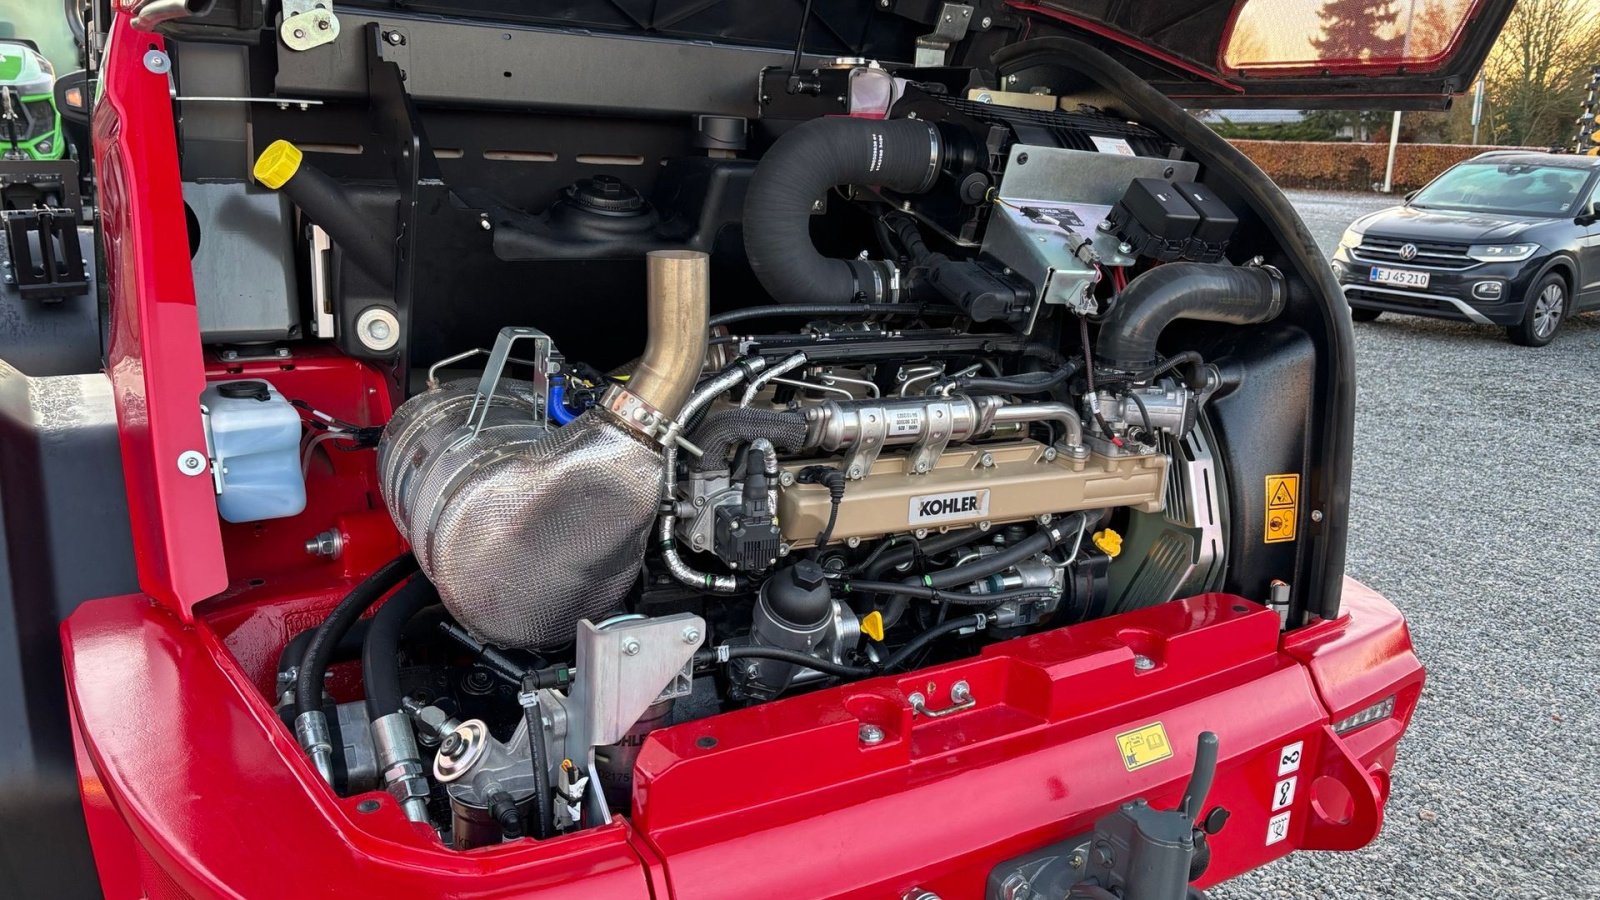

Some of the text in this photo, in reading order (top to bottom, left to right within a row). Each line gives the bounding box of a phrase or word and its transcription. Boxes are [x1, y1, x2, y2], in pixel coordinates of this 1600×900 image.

[1377, 270, 1391, 281] EJ
[1407, 273, 1427, 285] 210
[919, 496, 978, 517] KOHLER
